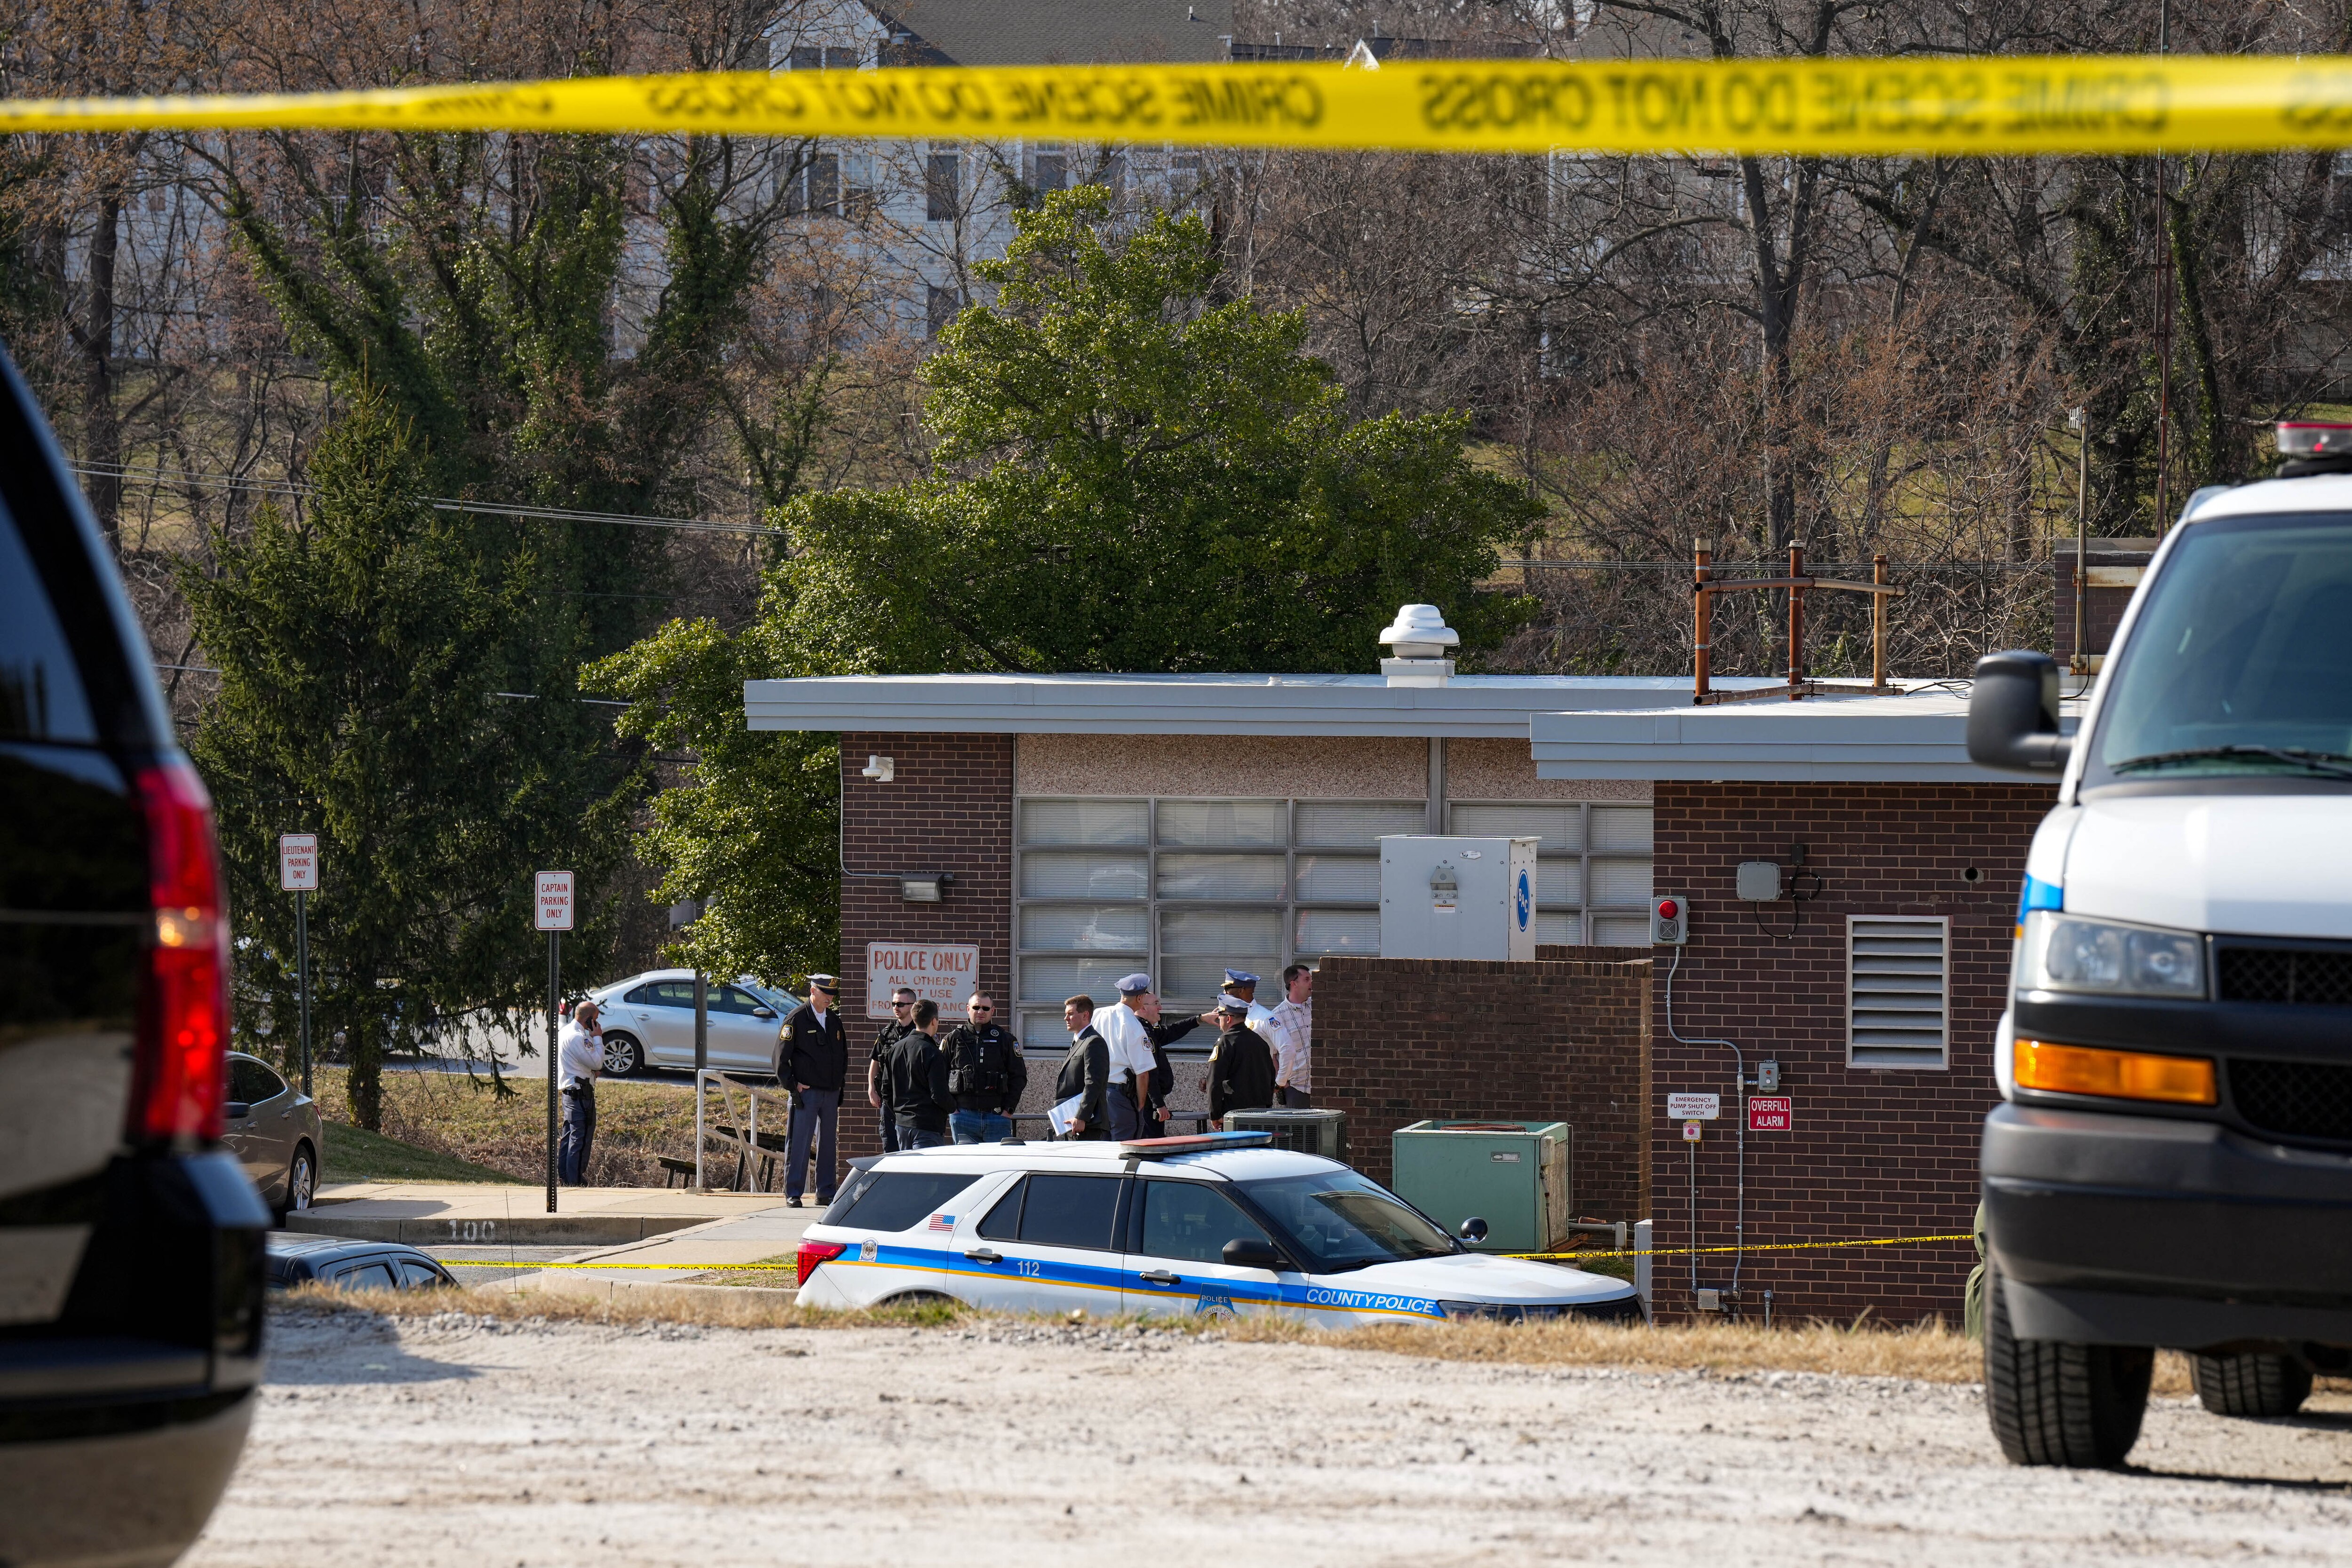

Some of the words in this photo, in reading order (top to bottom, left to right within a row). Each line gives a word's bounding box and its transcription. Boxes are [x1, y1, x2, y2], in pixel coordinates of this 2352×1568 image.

[283, 846, 314, 855] LIEUTENANT
[288, 858, 310, 867] PARKING
[293, 870, 306, 879] ONLY
[541, 883, 568, 893] CAPTAIN
[541, 896, 568, 905] PARKING
[1518, 888, 1528, 913] BAC
[546, 909, 563, 918] ONLY
[874, 950, 927, 970] POLICE
[932, 951, 973, 971] ONLY
[888, 975, 908, 985] ALL
[913, 975, 957, 986] OTHERS
[930, 989, 953, 998] USE
[872, 1000, 891, 1010] FRO
[1751, 1100, 1788, 1112] OVERFILL
[1756, 1116, 1784, 1126] ALARM
[1017, 1260, 1040, 1276] 112
[1306, 1289, 1375, 1307] COUNTY
[1375, 1296, 1436, 1313] POLICE
